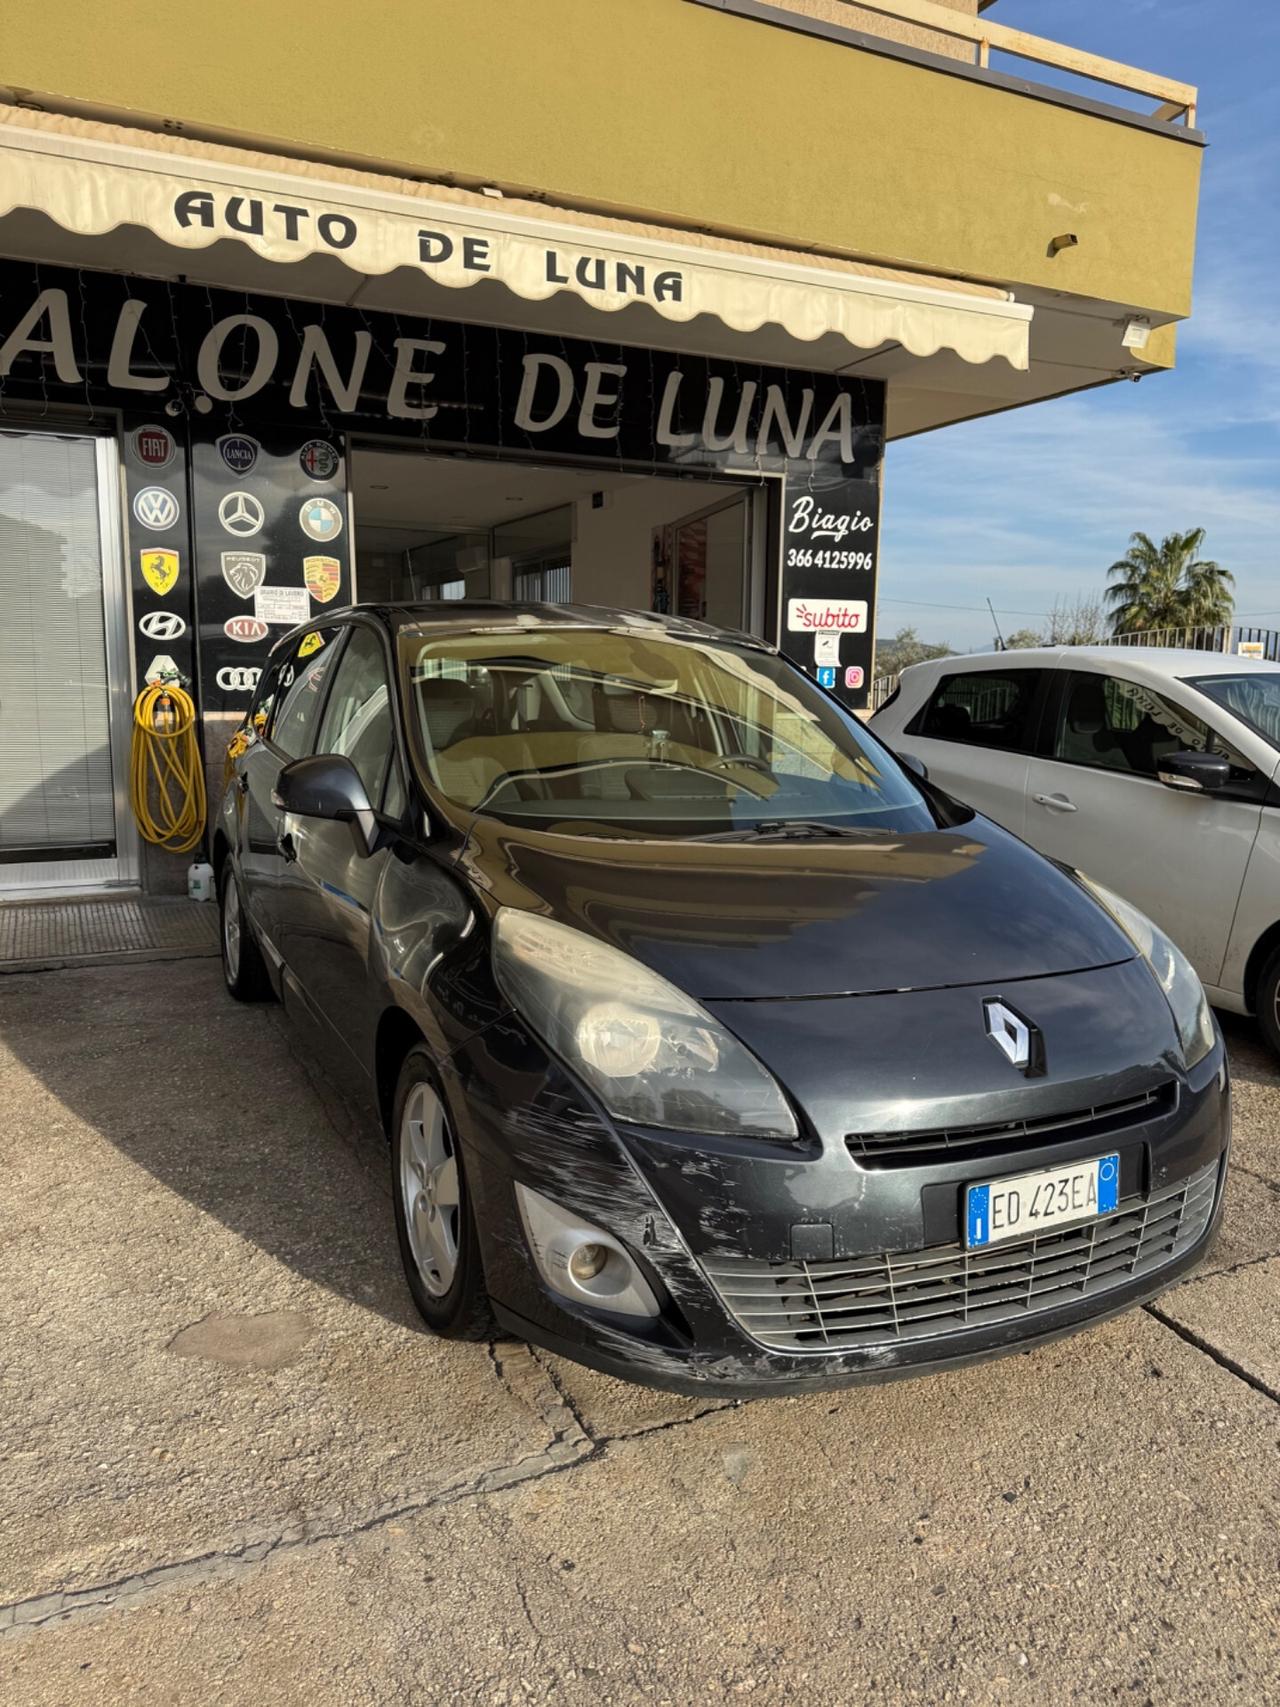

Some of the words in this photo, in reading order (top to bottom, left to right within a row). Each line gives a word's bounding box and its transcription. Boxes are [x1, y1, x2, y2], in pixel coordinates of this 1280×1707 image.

[174, 190, 357, 249] AUTO
[418, 229, 491, 272] DE
[546, 250, 683, 302] LUNA
[514, 353, 628, 439] DE
[656, 370, 856, 463] LUNA
[142, 438, 167, 457] FIAT
[226, 448, 252, 460] LANCIA
[788, 496, 874, 542] Biagio
[787, 548, 813, 568] 366
[814, 549, 873, 570] 4125996
[231, 622, 262, 635] KIA
[803, 607, 861, 629] subito
[992, 1190, 1020, 1229] ED
